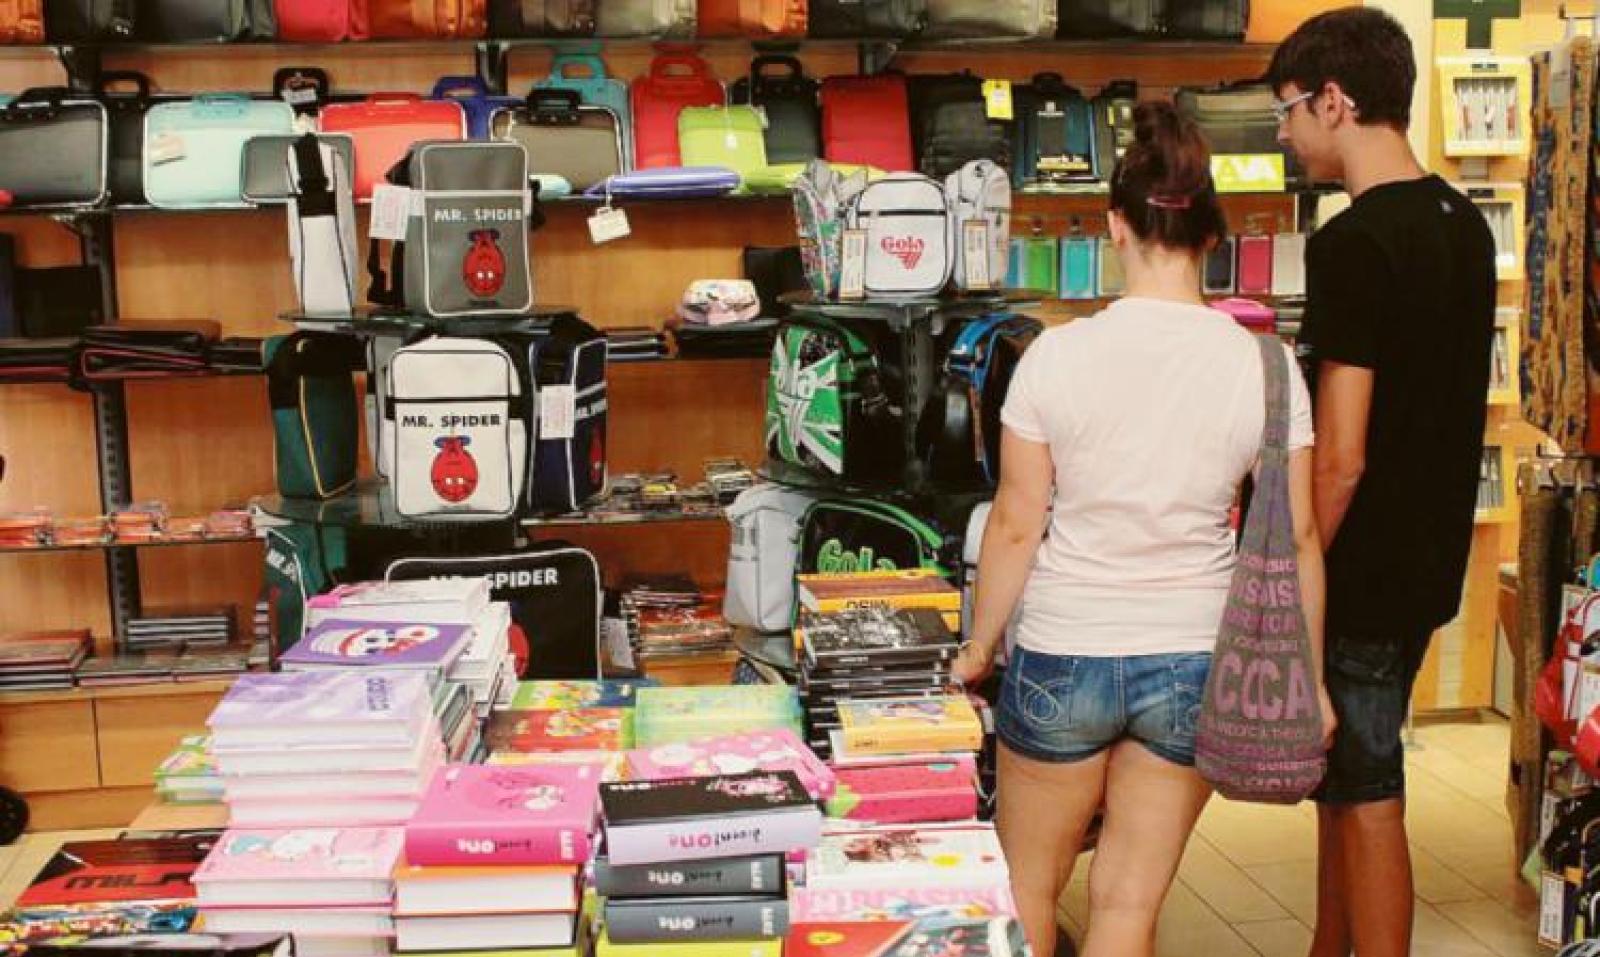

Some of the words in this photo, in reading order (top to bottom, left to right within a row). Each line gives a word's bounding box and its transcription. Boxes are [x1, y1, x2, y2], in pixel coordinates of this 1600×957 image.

[434, 208, 467, 223] MR.
[473, 207, 522, 221] SPIDER
[881, 235, 925, 250] Gola
[402, 415, 434, 428] MR.
[441, 413, 500, 428] SPIDER
